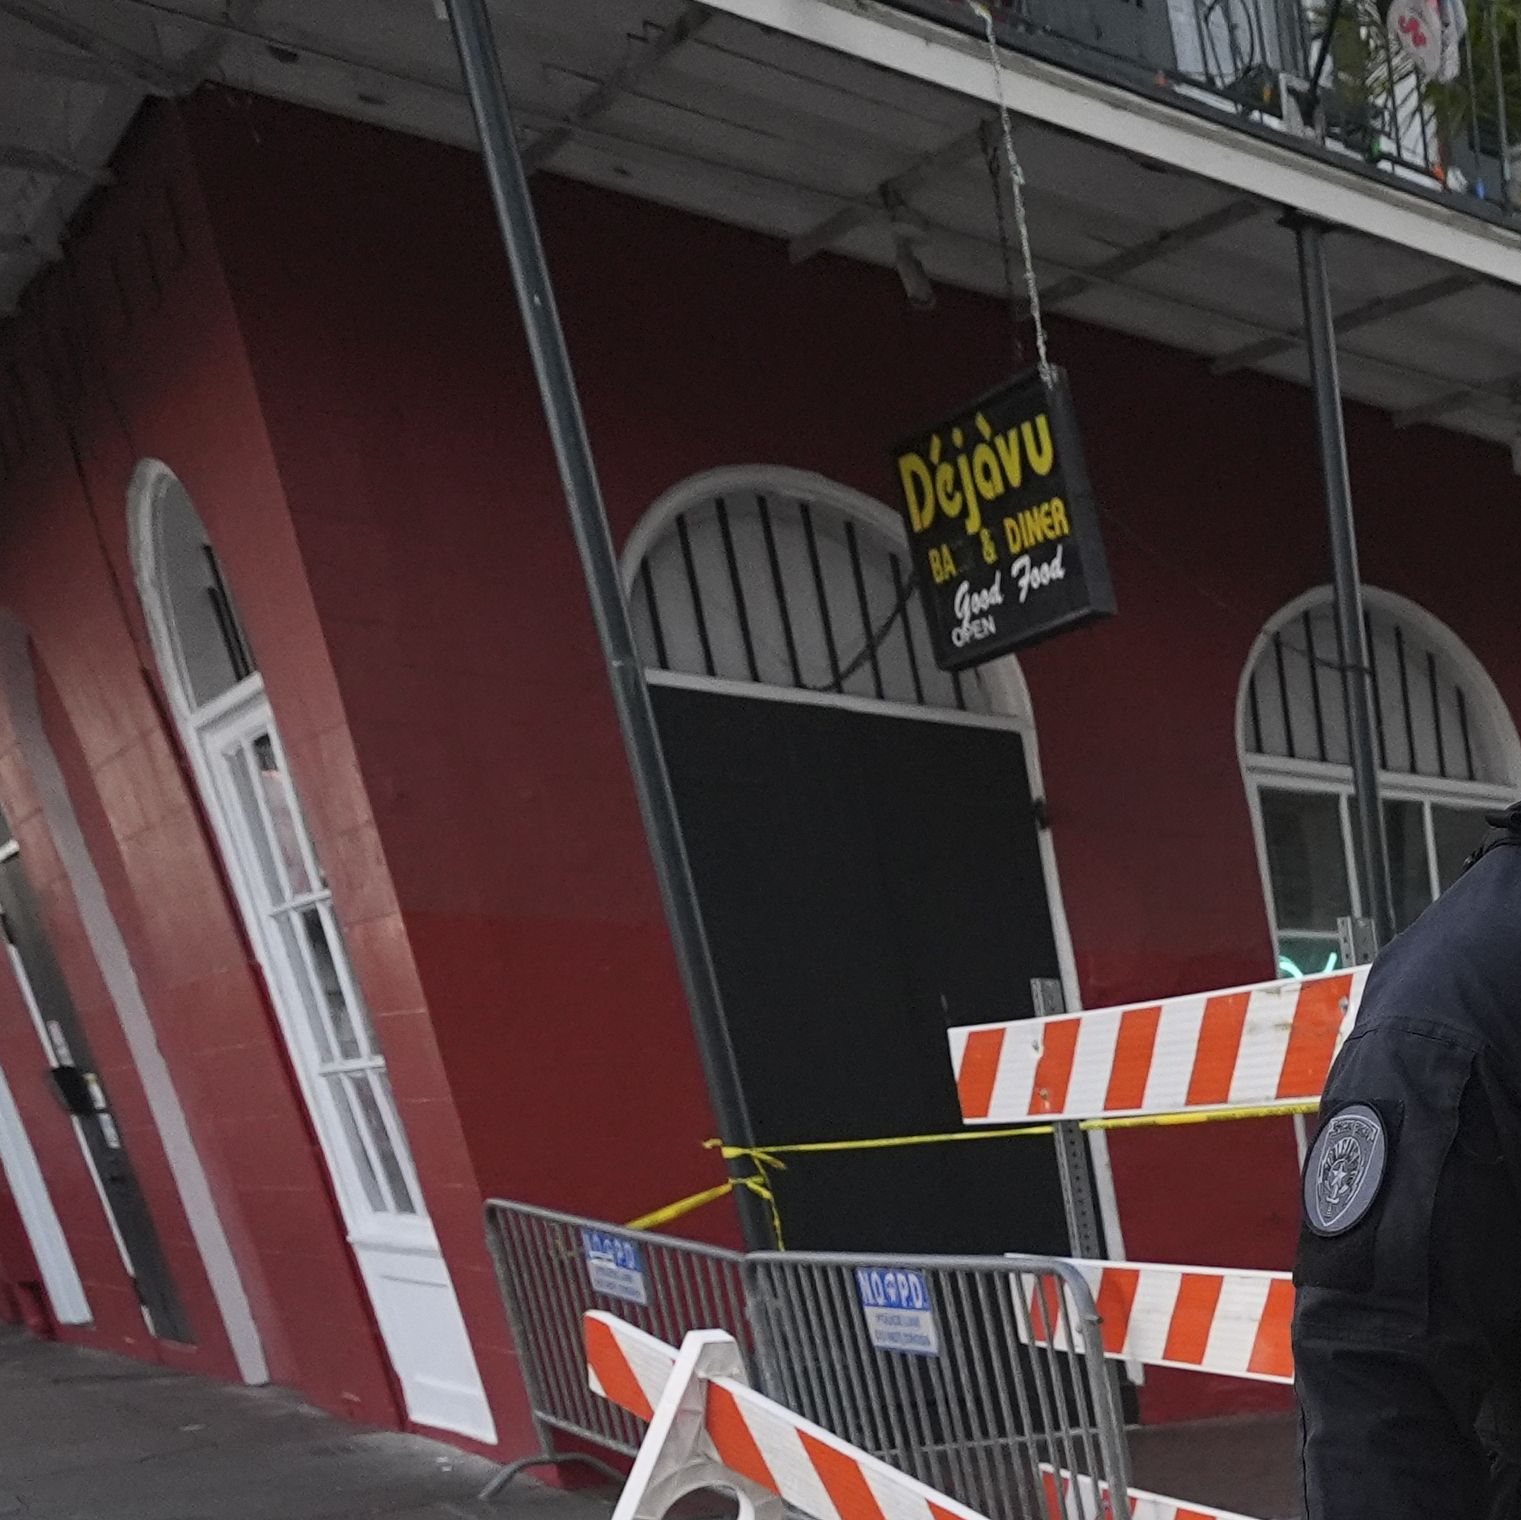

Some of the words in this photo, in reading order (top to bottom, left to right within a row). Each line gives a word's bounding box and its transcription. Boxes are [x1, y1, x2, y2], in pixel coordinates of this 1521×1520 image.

[979, 527, 998, 565] &
[1003, 496, 1070, 555] DINER
[954, 569, 1004, 627] Good
[1011, 543, 1066, 603] Food
